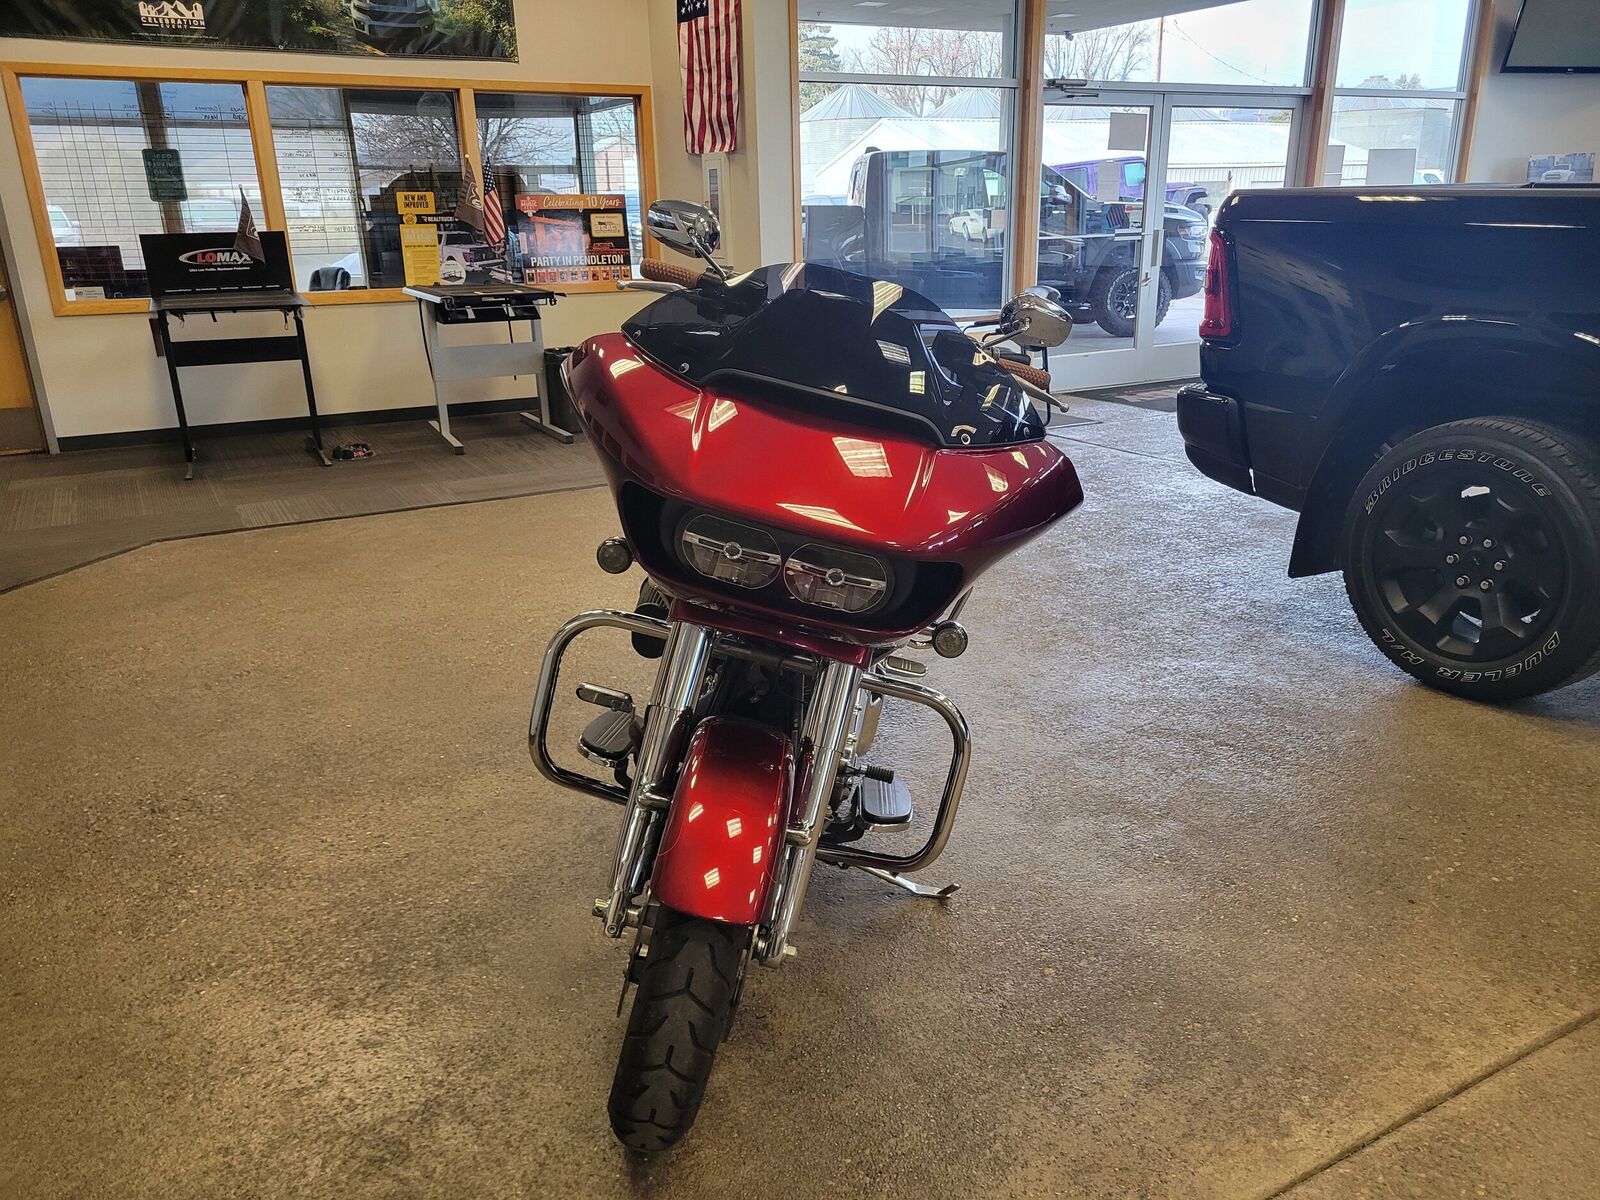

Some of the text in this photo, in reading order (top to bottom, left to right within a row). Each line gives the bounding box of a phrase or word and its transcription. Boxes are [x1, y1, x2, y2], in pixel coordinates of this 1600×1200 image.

[141, 16, 206, 26] CELEBRATION
[403, 201, 429, 209] IMPROVED
[543, 195, 623, 213] Celebrating 10 Years
[196, 251, 252, 265] LOMAX
[530, 254, 624, 267] PARTY IN PENDLETON
[1364, 449, 1552, 515] BRIDGESTONE
[1382, 628, 1561, 683] DUELER H/L
